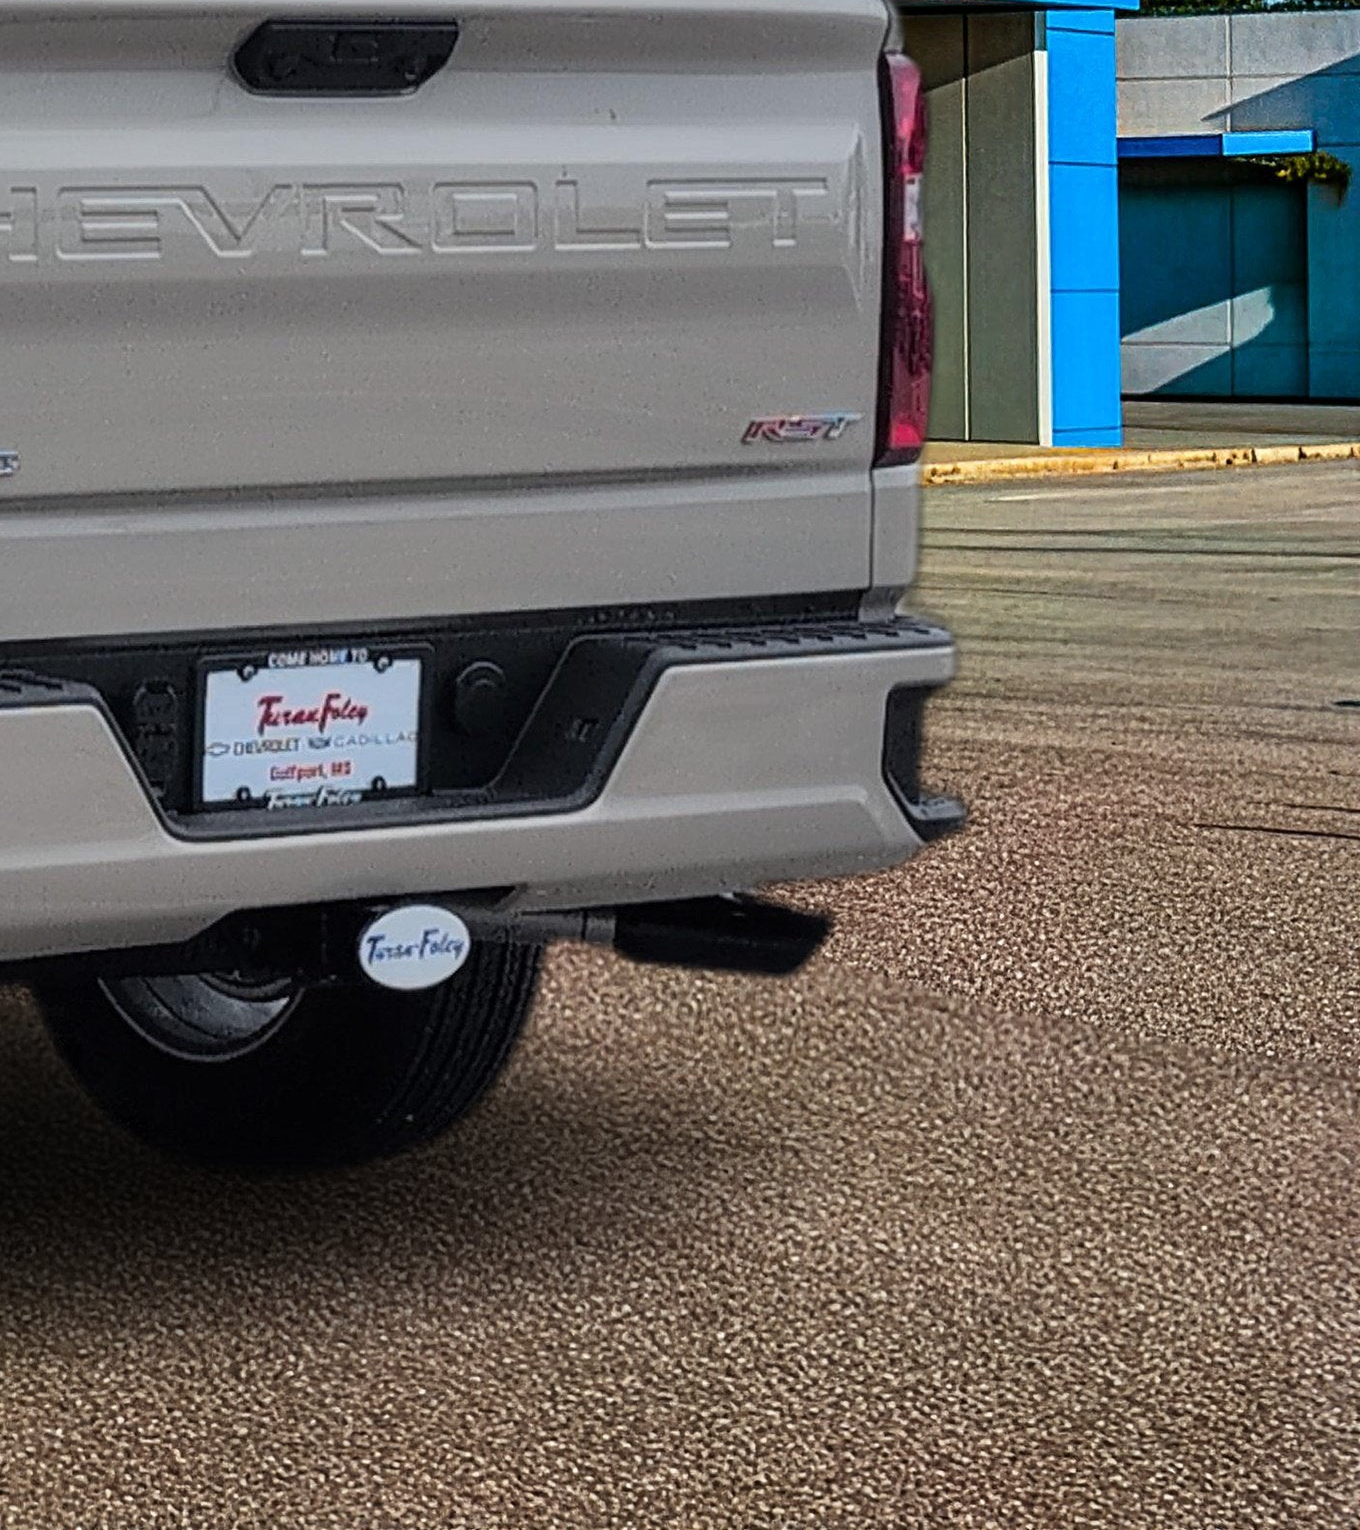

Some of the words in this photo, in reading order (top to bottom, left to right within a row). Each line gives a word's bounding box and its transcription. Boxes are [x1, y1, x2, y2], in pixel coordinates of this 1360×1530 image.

[740, 411, 865, 445] RST
[267, 651, 306, 669] COME
[350, 647, 369, 663] TO
[333, 731, 417, 749] CADILLAC
